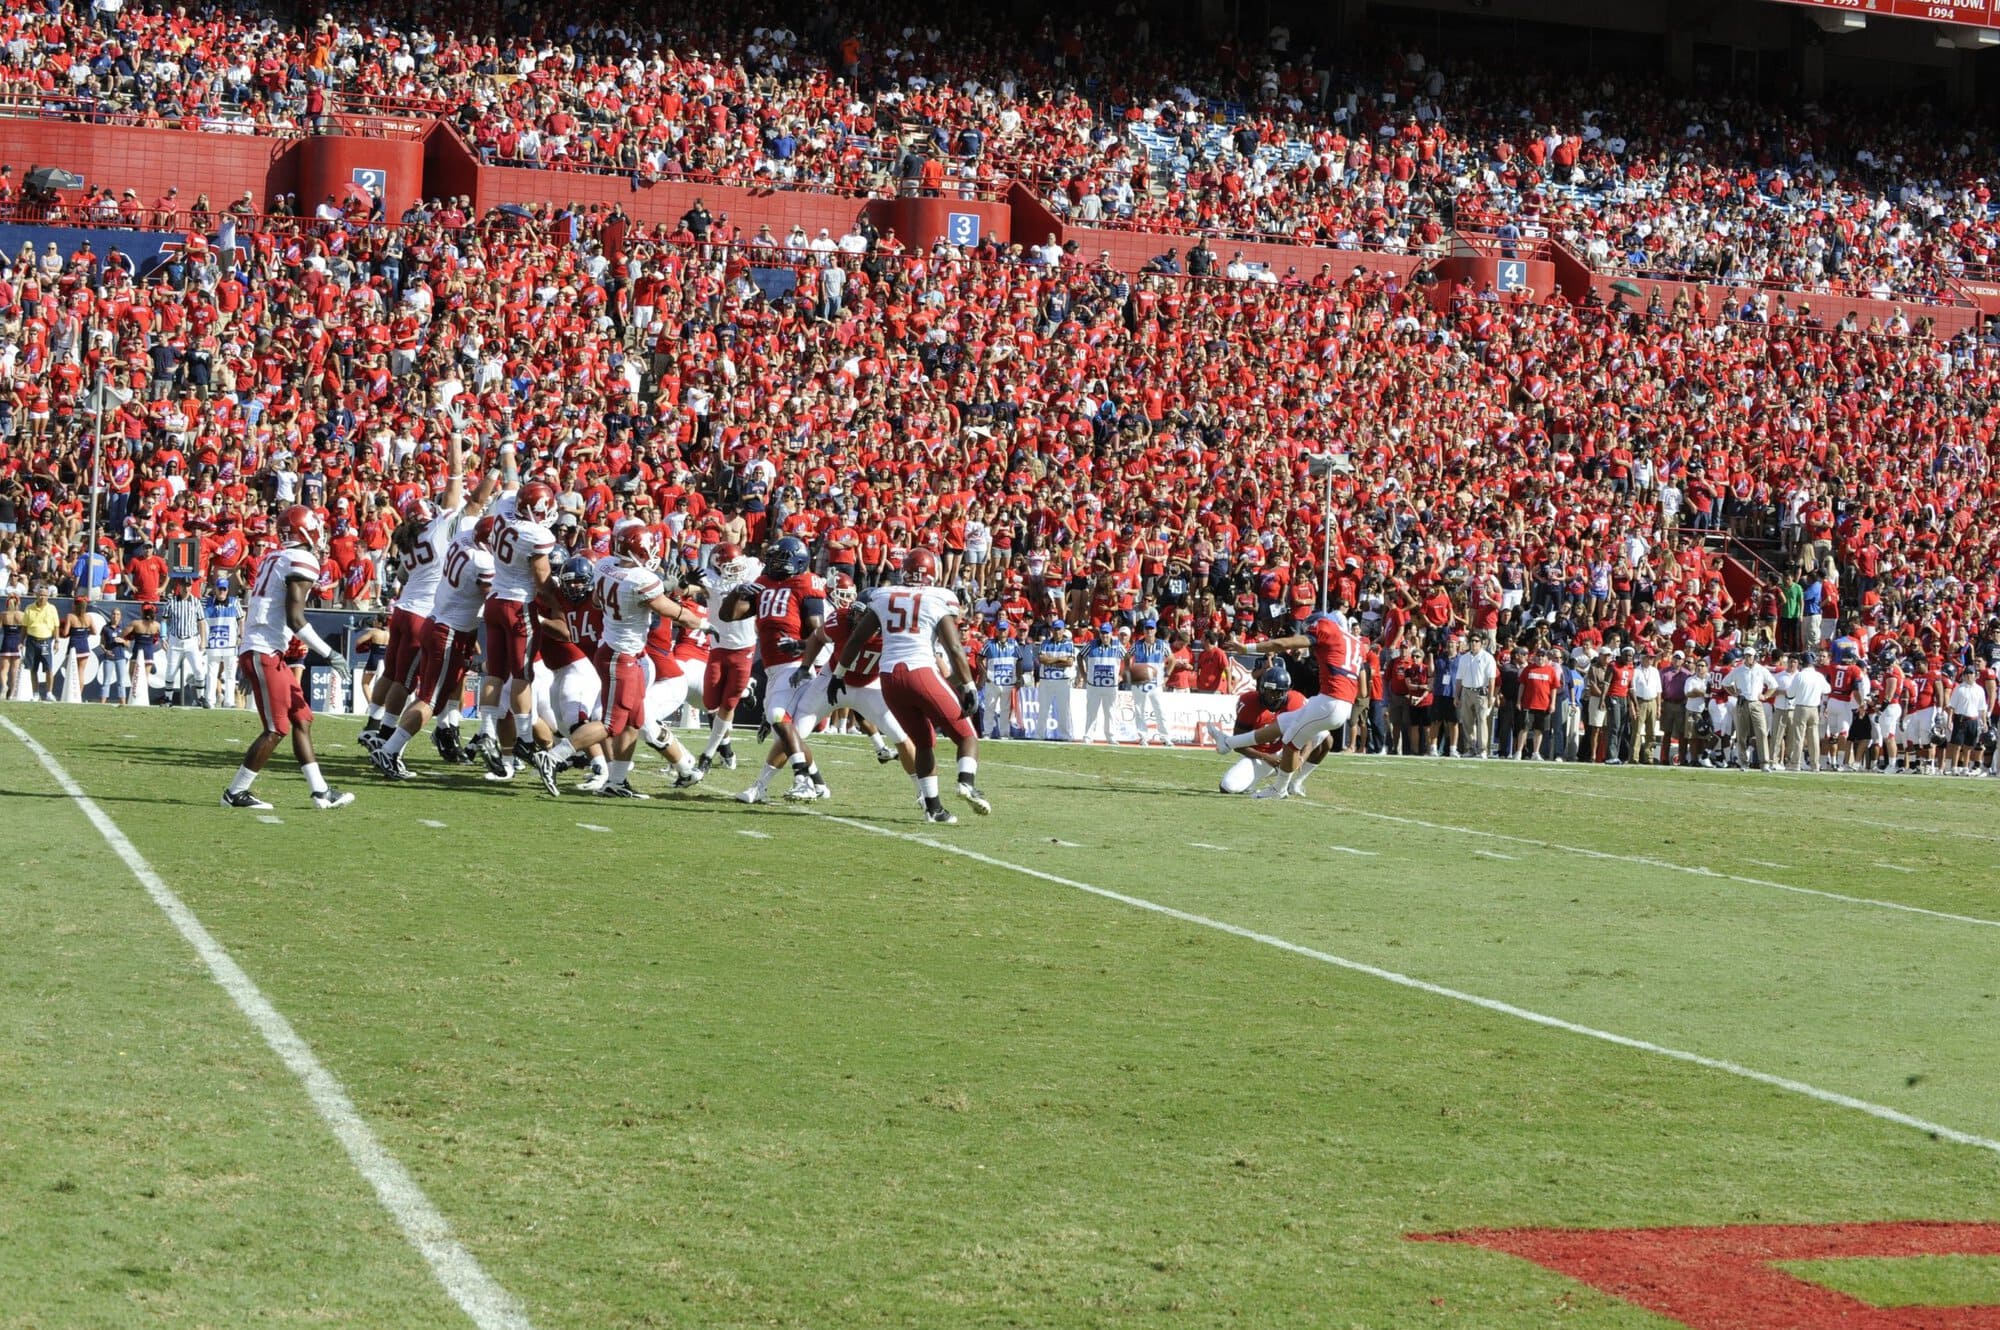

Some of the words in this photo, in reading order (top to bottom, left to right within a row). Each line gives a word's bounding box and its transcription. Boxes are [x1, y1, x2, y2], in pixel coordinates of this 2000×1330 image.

[1928, 7, 1954, 19] 1994
[362, 171, 376, 192] 2
[956, 216, 971, 236] 3
[1504, 263, 1519, 282] 4
[177, 541, 189, 567] 1
[912, 572, 923, 582] 51
[759, 588, 791, 618] 88
[886, 592, 922, 634] 51
[567, 611, 597, 643] 64
[209, 639, 229, 648] 10
[995, 676, 1013, 685] 10
[1045, 670, 1064, 679] 10
[1094, 678, 1114, 687] 10
[1834, 670, 1844, 688] 8
